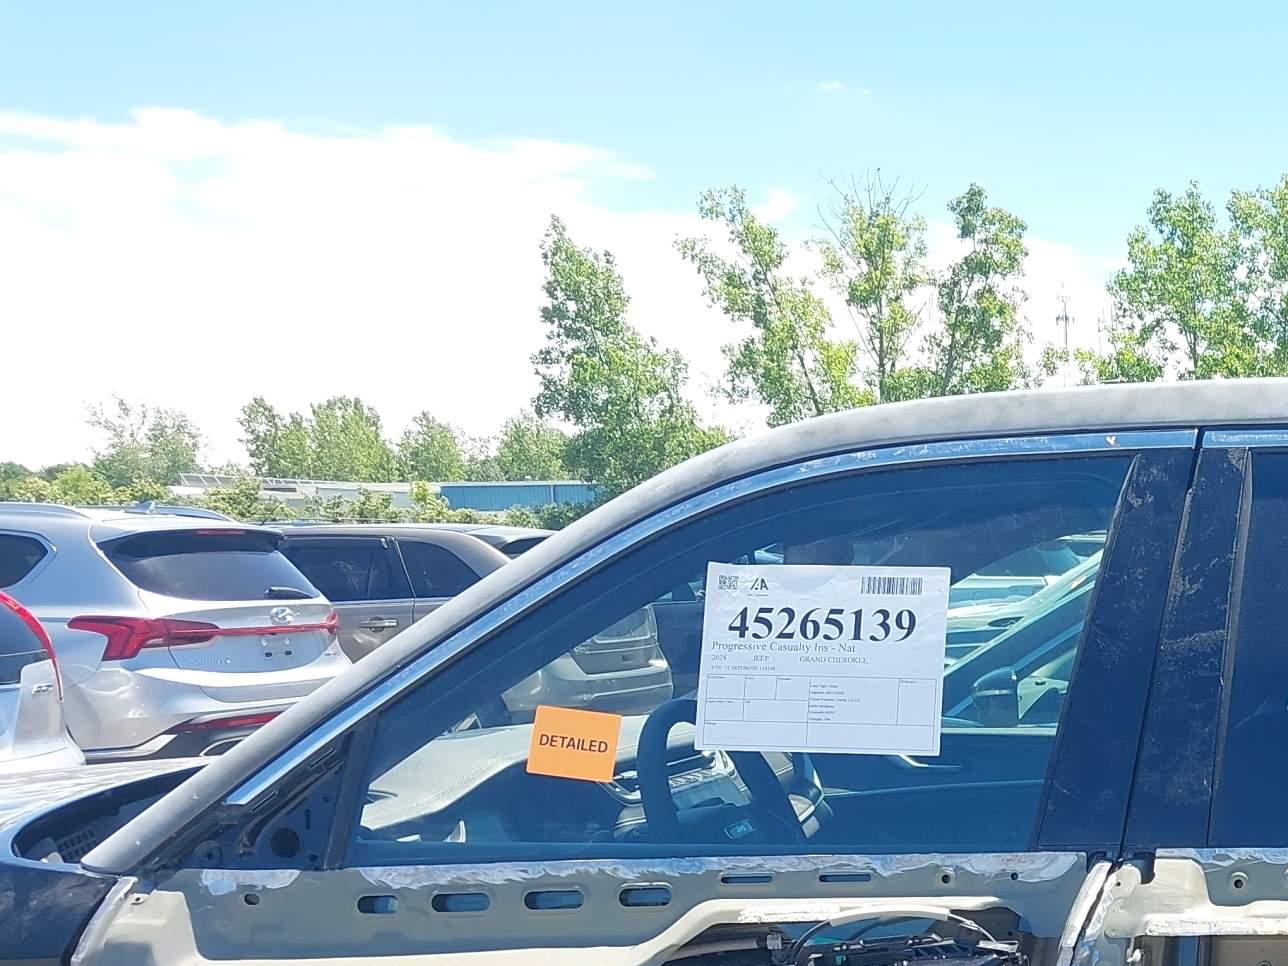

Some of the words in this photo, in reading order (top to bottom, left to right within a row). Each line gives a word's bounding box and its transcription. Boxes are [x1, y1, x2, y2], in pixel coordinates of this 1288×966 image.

[728, 606, 917, 642] 45265139
[711, 640, 767, 653] Progressive
[769, 641, 811, 654] Casualty
[814, 643, 829, 653] Ins
[838, 643, 856, 653] Nat
[539, 733, 608, 753] DETAILED
